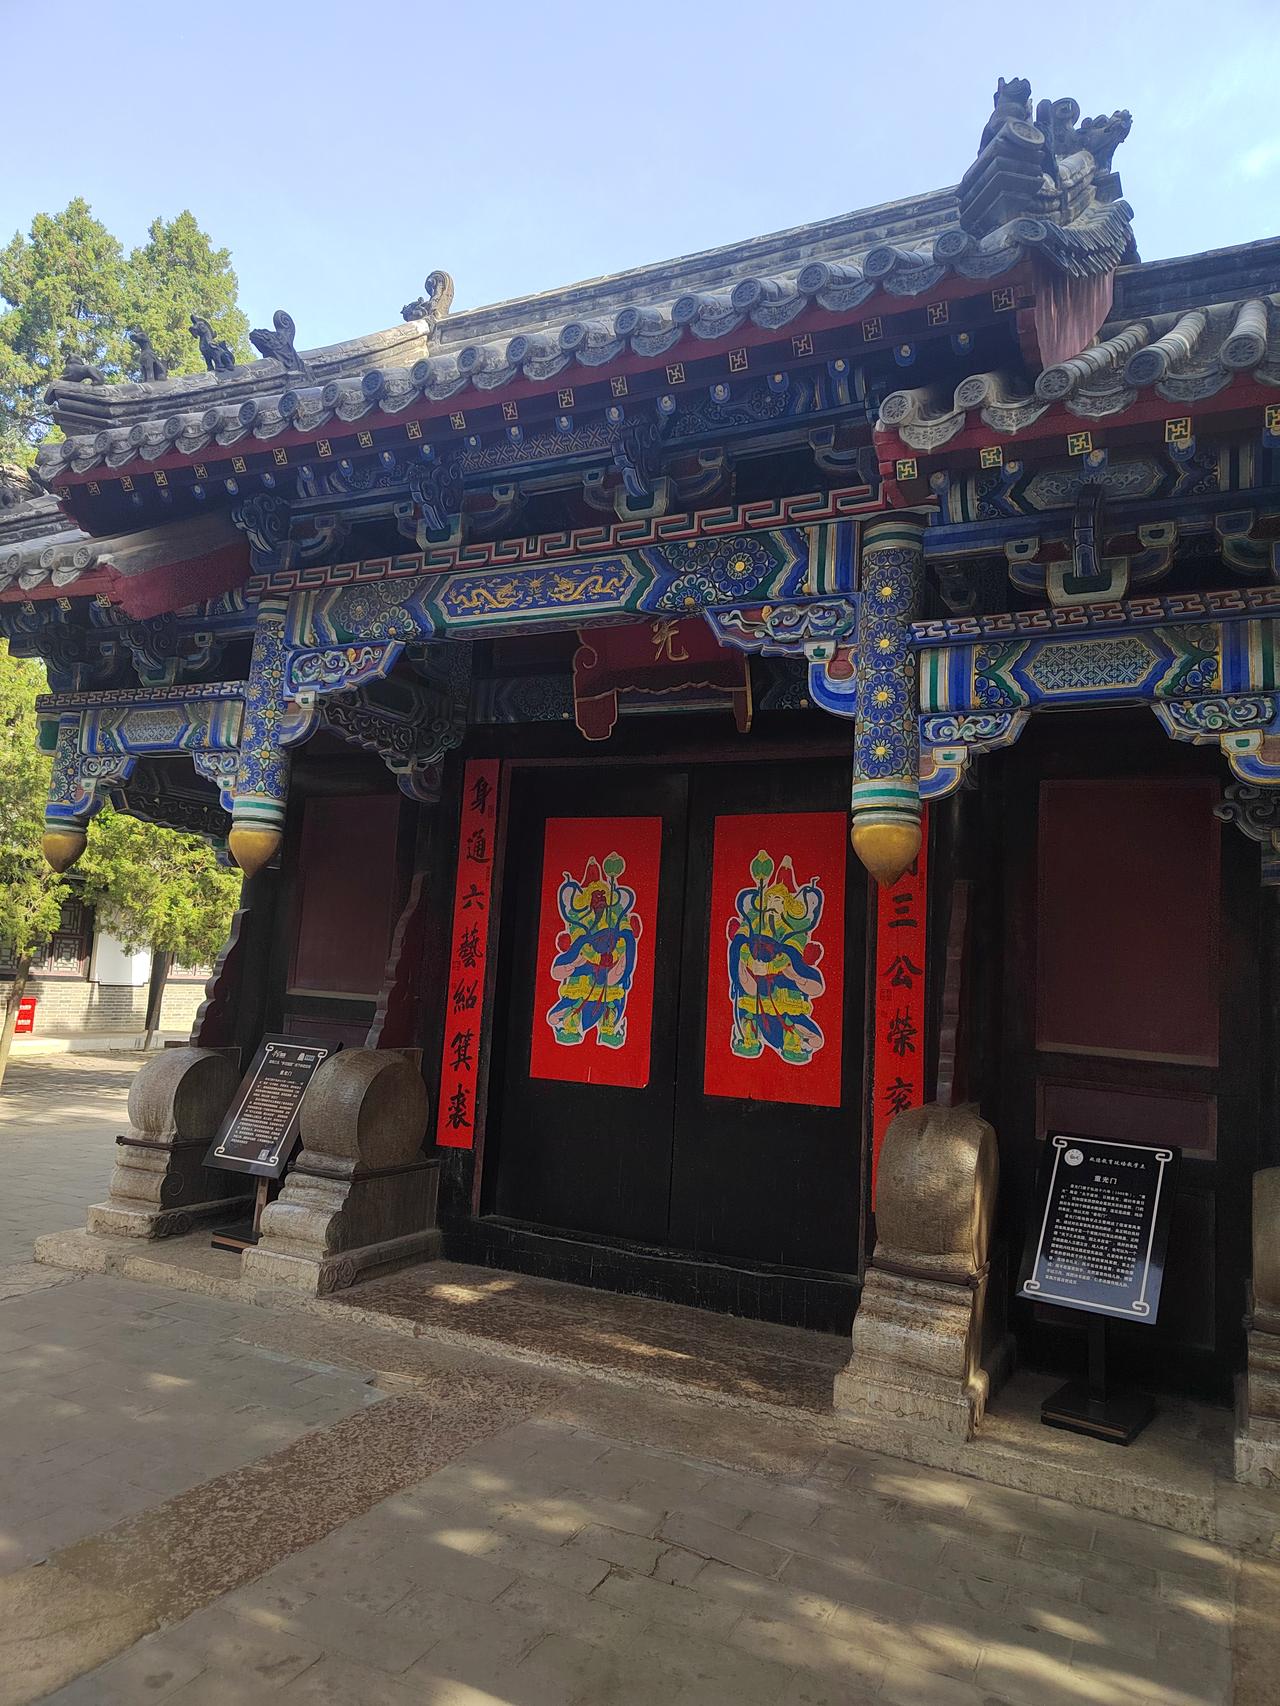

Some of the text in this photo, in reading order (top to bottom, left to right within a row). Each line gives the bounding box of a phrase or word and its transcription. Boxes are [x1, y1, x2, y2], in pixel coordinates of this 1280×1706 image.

[652, 619, 689, 662] 光
[1093, 1175, 1117, 1185] 重光门
